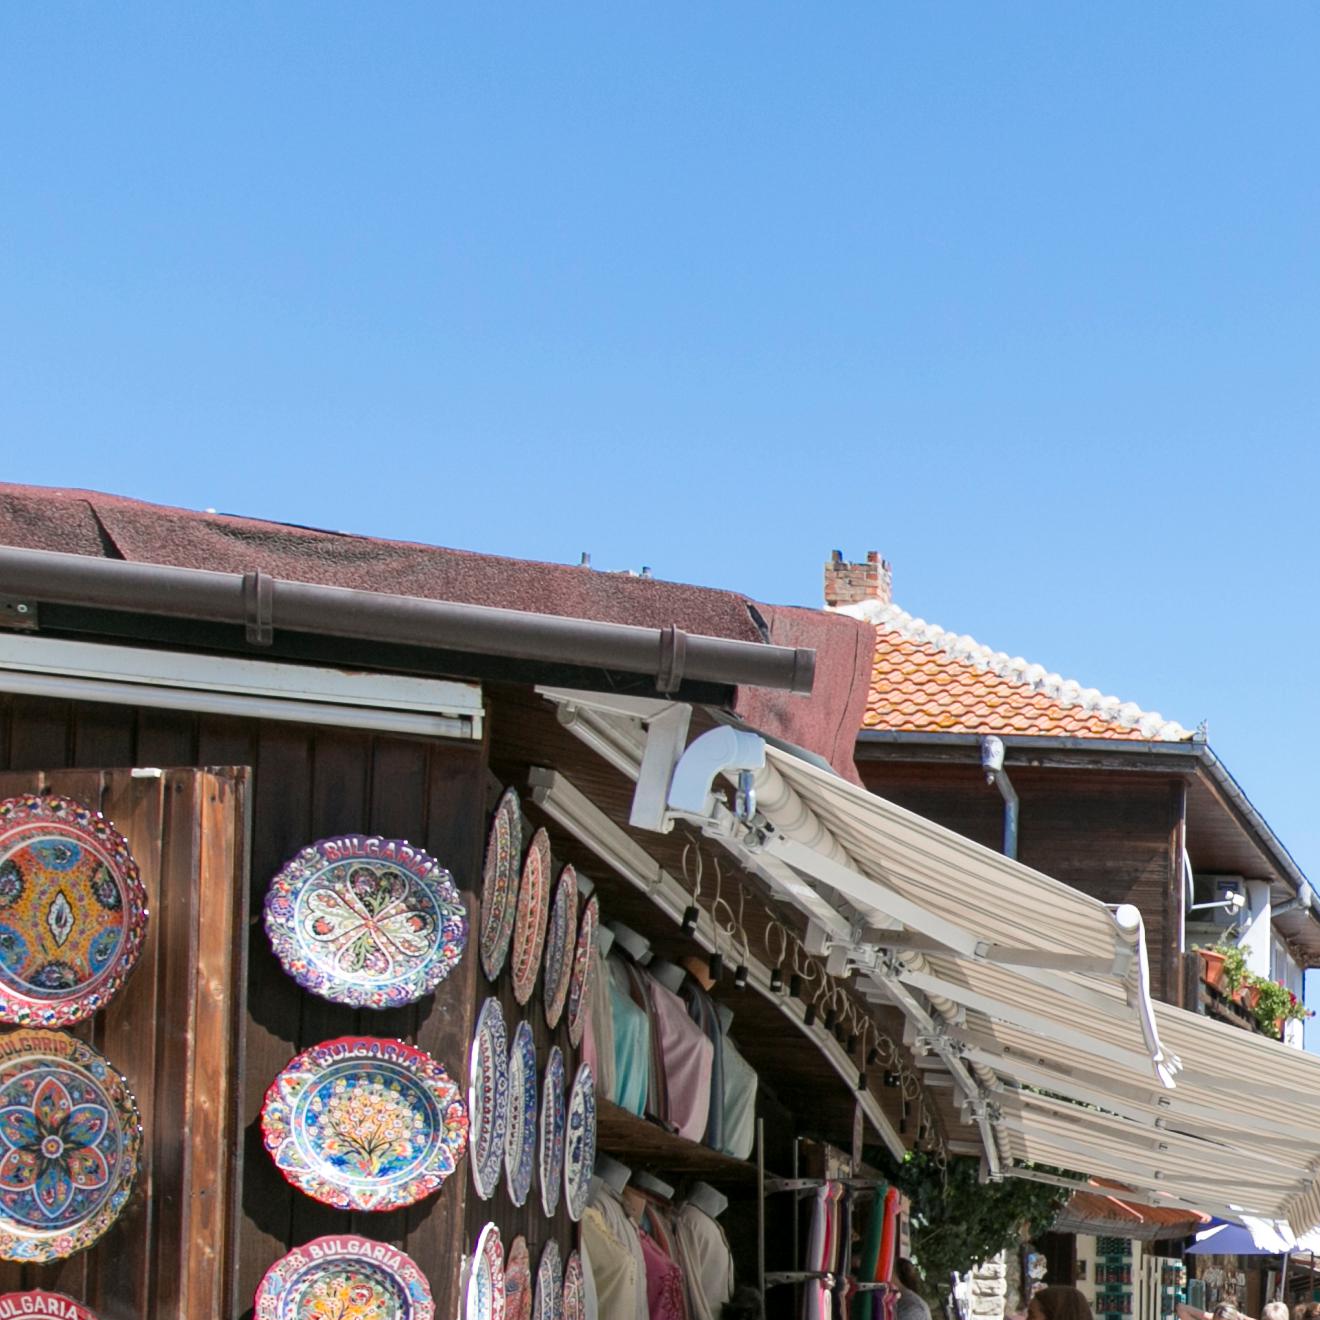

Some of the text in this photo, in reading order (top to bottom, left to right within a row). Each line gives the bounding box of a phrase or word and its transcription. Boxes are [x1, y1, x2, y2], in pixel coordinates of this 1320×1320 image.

[323, 837, 433, 876] BULGARIA
[0, 1036, 69, 1059] ULGARIA
[314, 1041, 420, 1072] BULGARIA
[309, 1239, 402, 1270] BULGARIA
